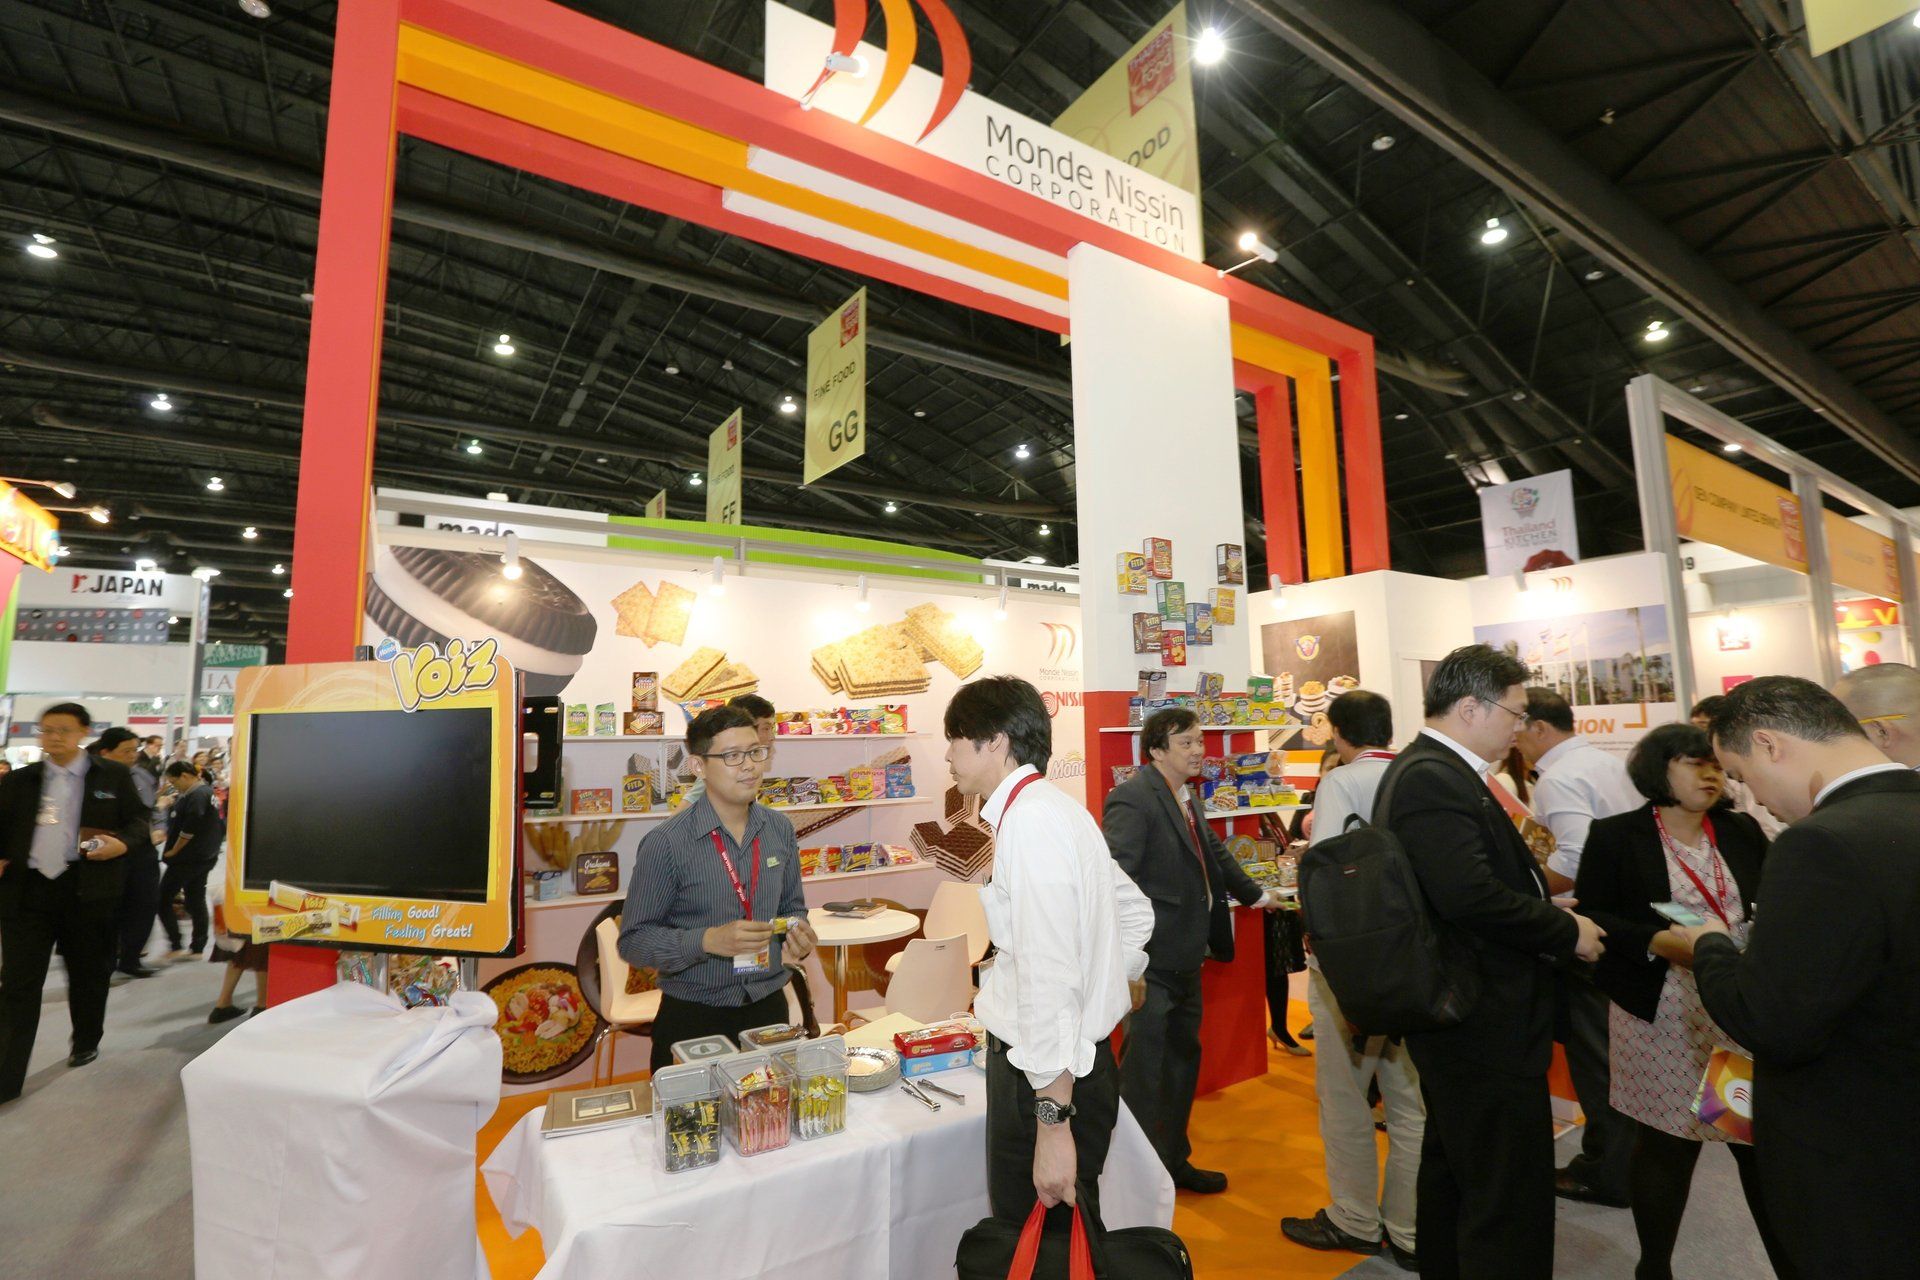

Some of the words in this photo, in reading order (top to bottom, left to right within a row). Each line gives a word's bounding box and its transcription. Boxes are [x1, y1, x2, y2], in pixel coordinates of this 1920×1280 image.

[1123, 126, 1171, 168] OOD
[986, 115, 1094, 191] Monde
[1105, 169, 1184, 230] Nissin
[985, 155, 1185, 253] CORPORATION
[832, 361, 857, 389] FOOD
[828, 409, 859, 453] GG
[90, 575, 163, 597] JAPAN
[371, 905, 404, 921] Filling
[407, 904, 440, 920] Good!
[385, 925, 426, 942] Feeling
[430, 924, 473, 938] Great!
